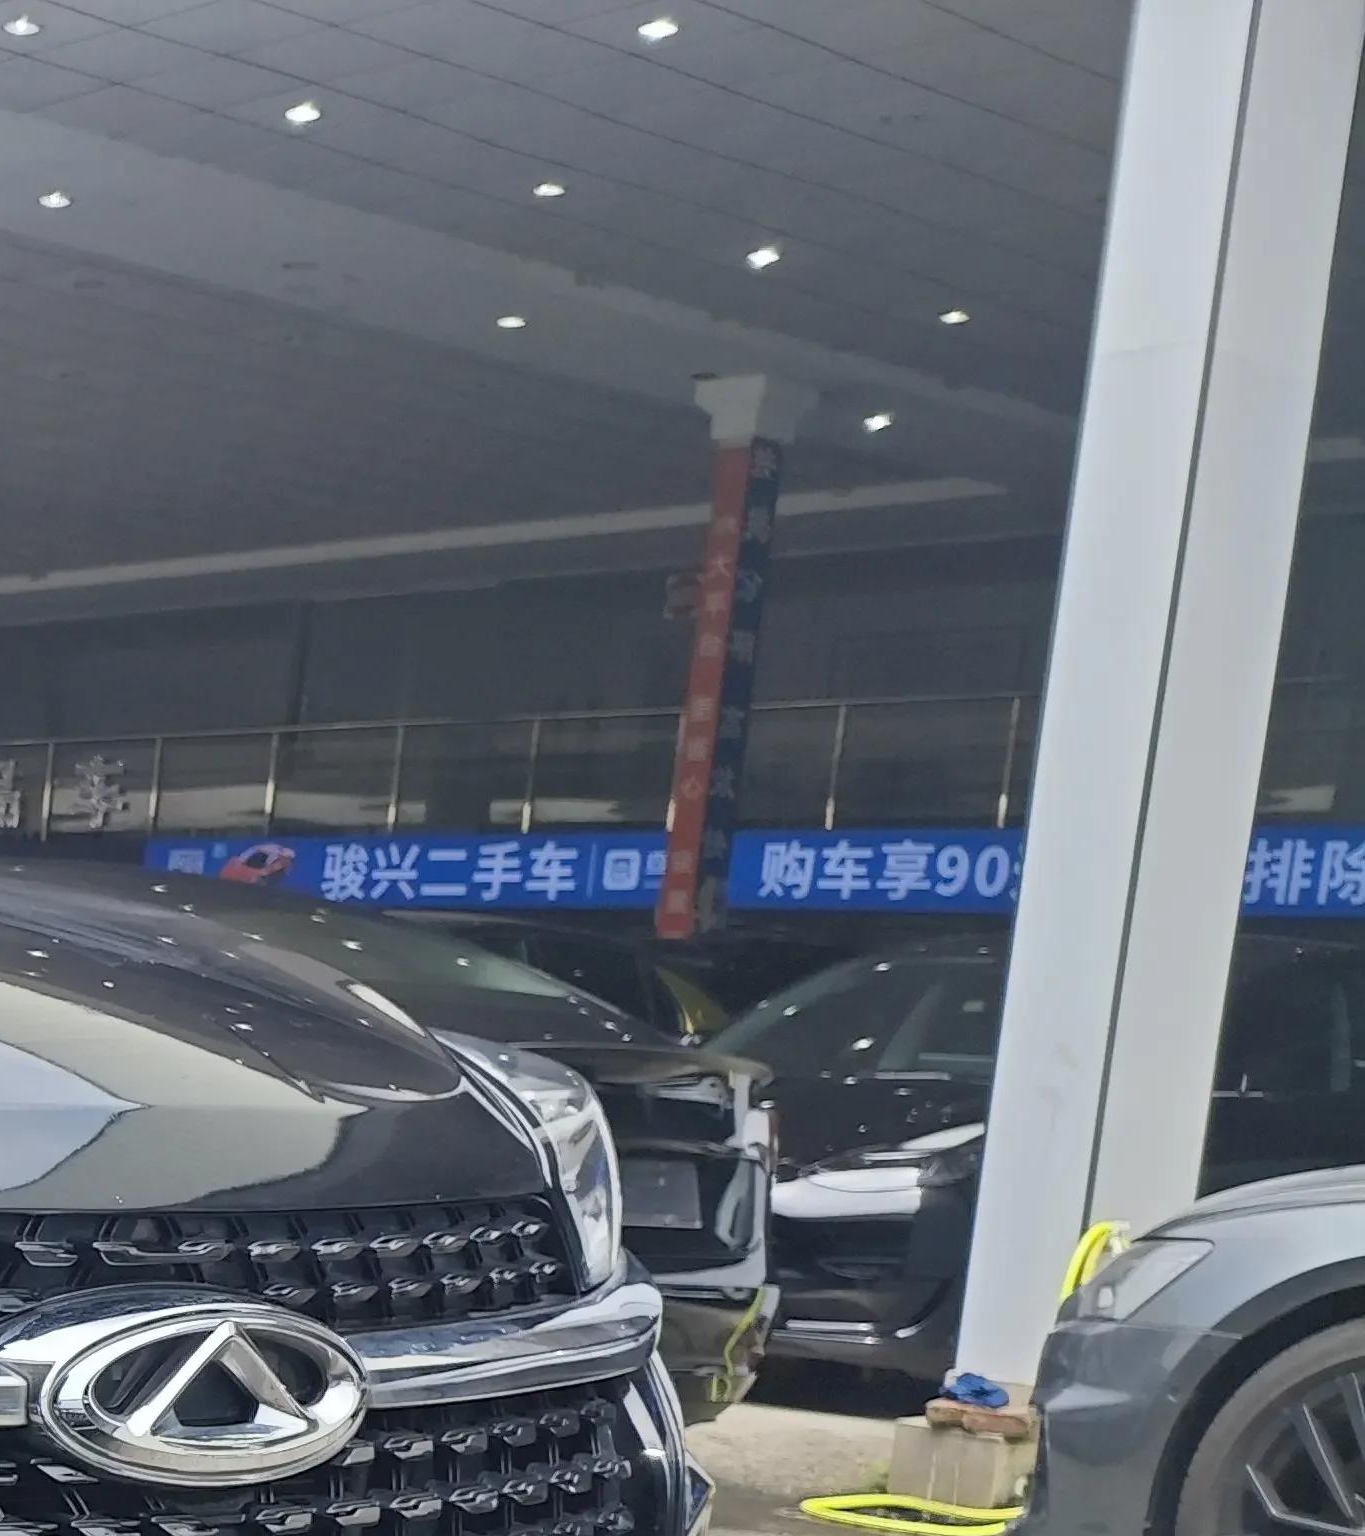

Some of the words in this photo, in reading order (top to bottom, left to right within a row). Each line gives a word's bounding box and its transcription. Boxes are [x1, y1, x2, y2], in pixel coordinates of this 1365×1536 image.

[319, 840, 580, 902] 骏兴二手车
[758, 838, 1021, 901] 购车享90
